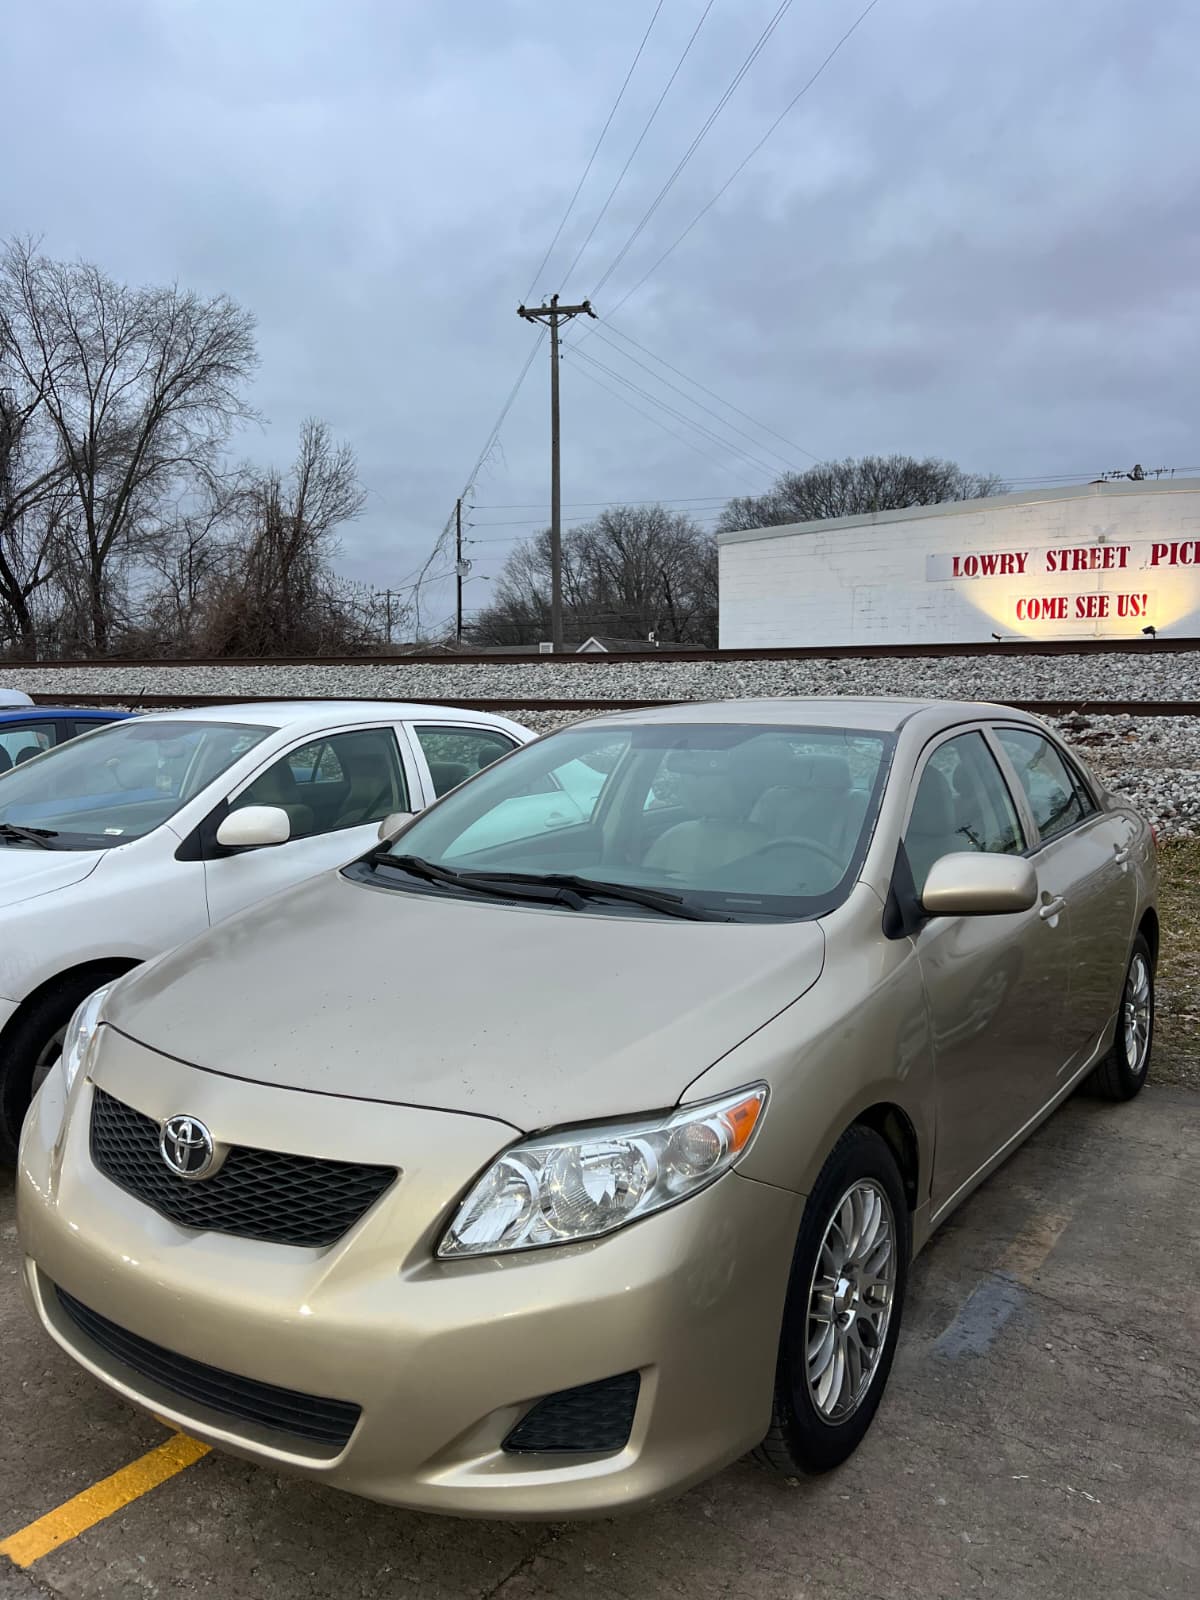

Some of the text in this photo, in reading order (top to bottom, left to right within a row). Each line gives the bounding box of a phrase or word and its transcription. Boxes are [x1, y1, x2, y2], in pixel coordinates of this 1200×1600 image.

[952, 552, 1029, 577] LOWRY
[1046, 546, 1131, 572] STREET
[1016, 593, 1149, 620] COME SEE US!
